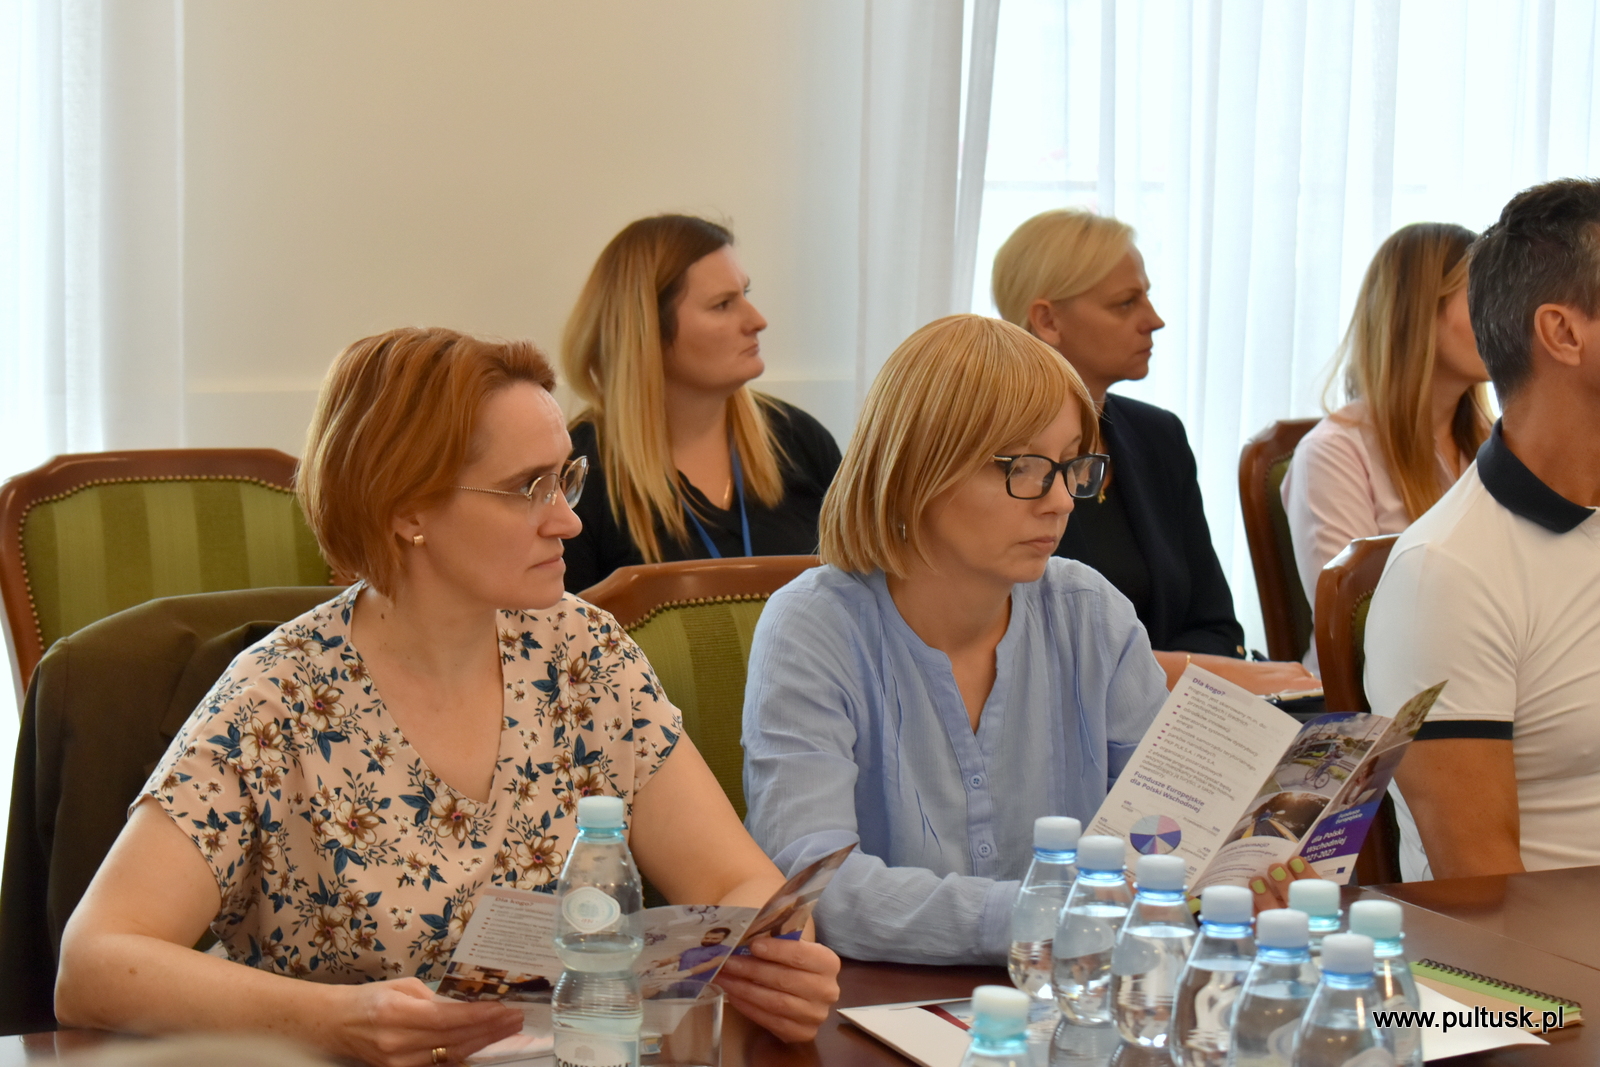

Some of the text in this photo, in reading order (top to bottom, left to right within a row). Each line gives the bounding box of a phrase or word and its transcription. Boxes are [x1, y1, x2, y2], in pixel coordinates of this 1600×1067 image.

[1193, 678, 1226, 697] Dla kogo?
[1188, 686, 1209, 699] Program
[1219, 702, 1246, 717] skierowany
[1130, 777, 1201, 812] dla Polski Wschodniej
[1134, 771, 1205, 806] Fundusze Europejskie
[1306, 836, 1348, 854] Wschodniej
[1311, 827, 1346, 844] dla Polski
